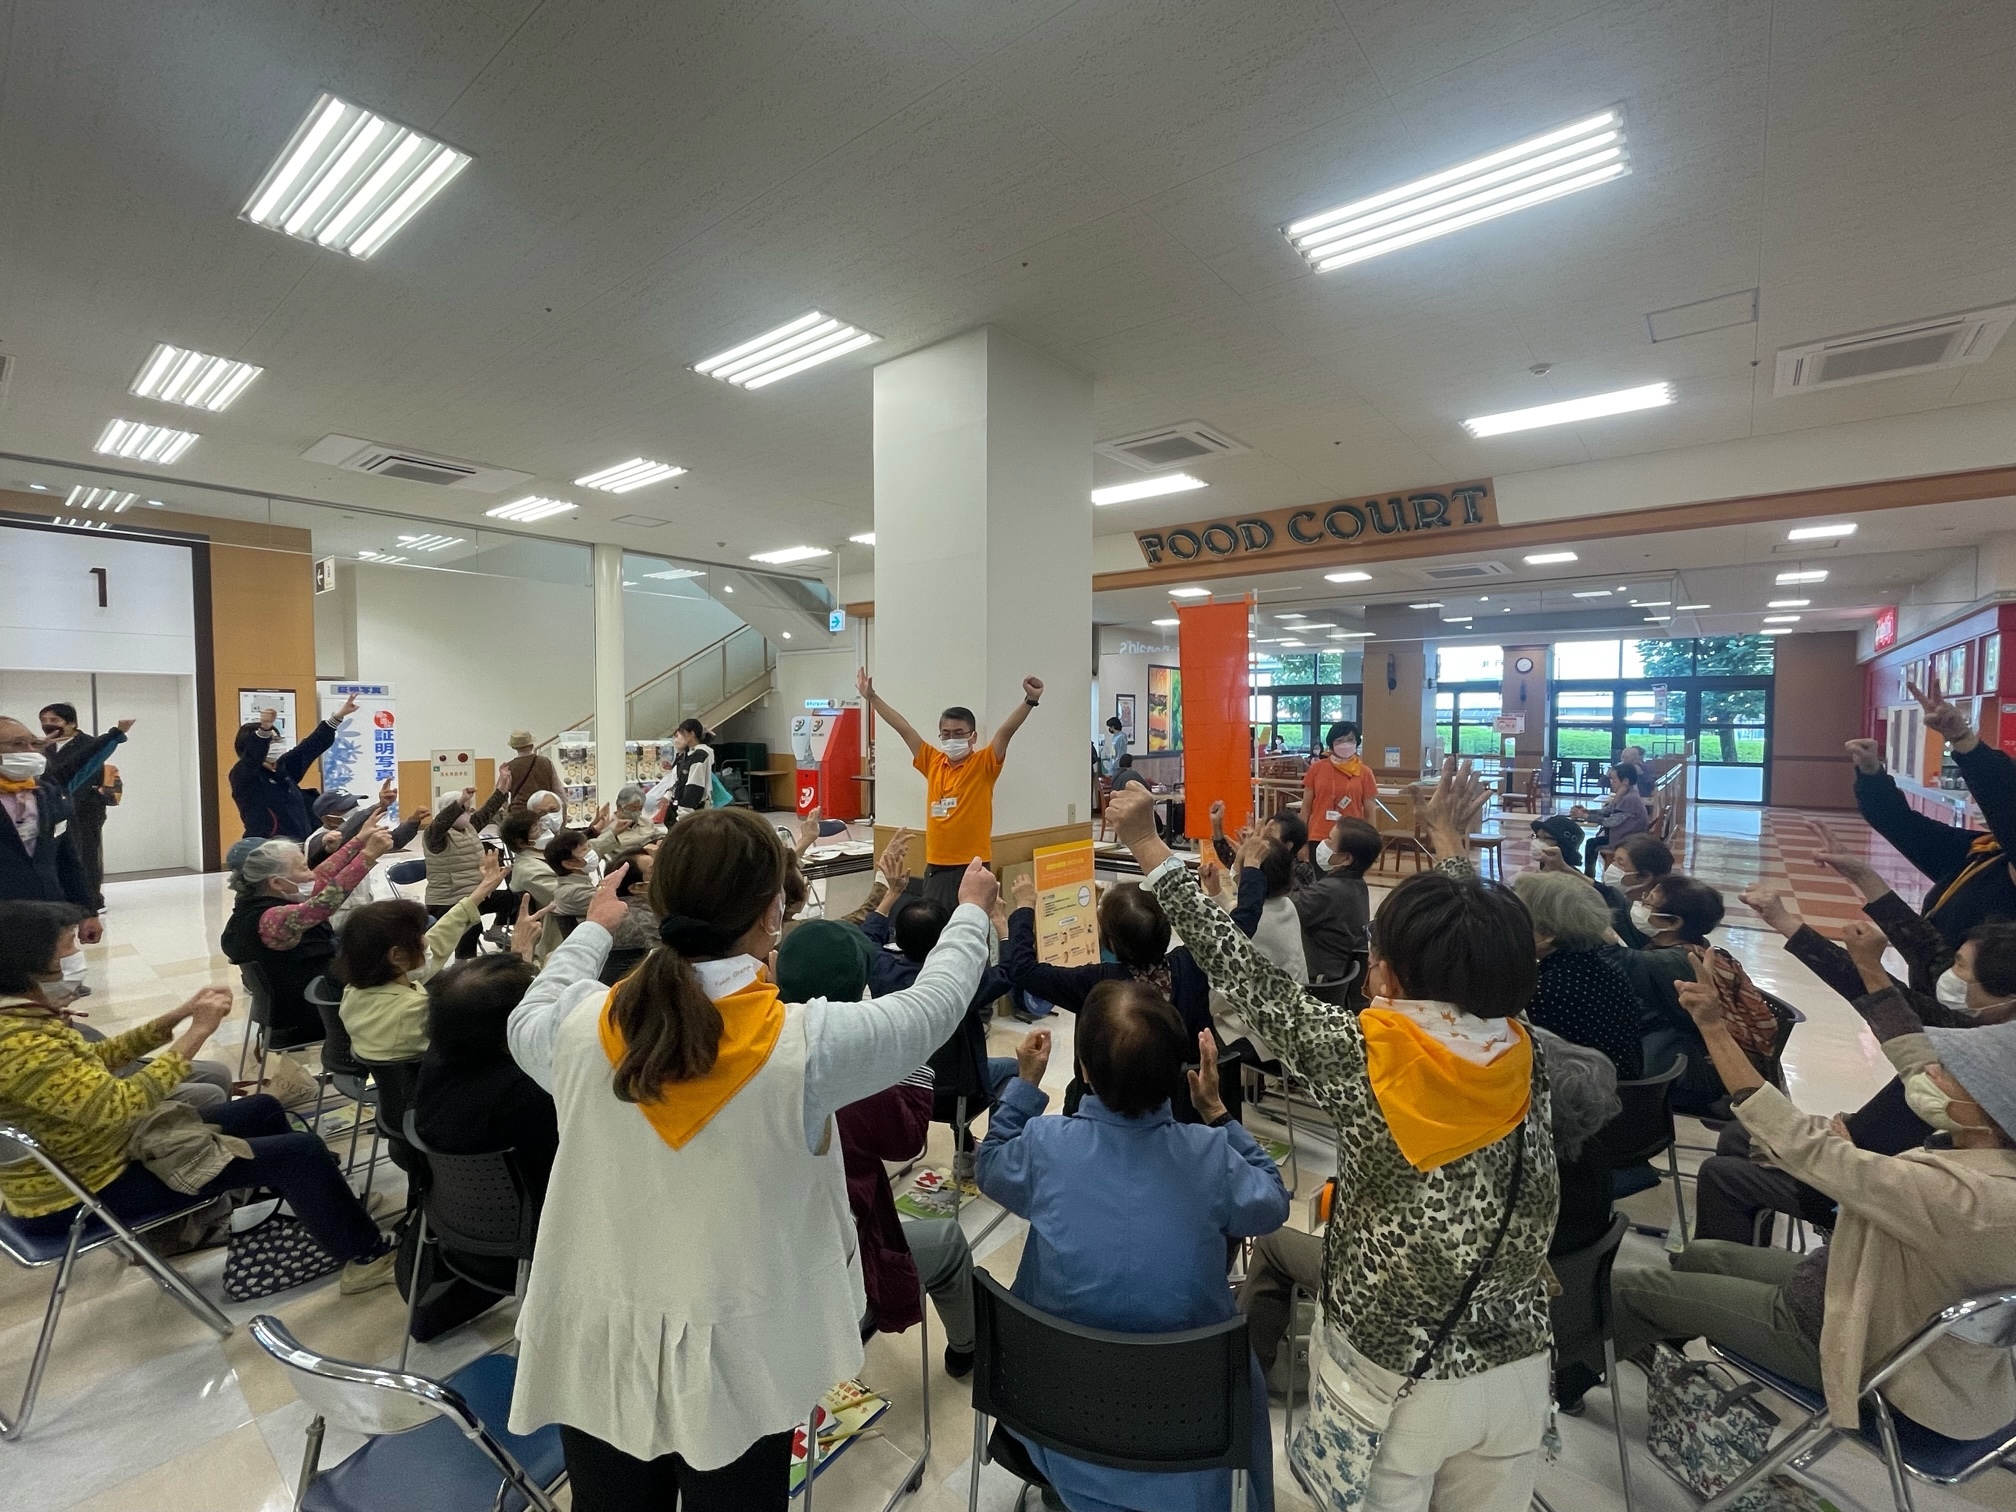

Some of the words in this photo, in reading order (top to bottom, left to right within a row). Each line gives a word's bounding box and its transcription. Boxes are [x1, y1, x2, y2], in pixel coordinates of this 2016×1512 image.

[1139, 519, 1275, 564] FOOD
[1286, 486, 1488, 544] COURT
[89, 567, 108, 608] 1
[374, 729, 395, 782] 証明写真
